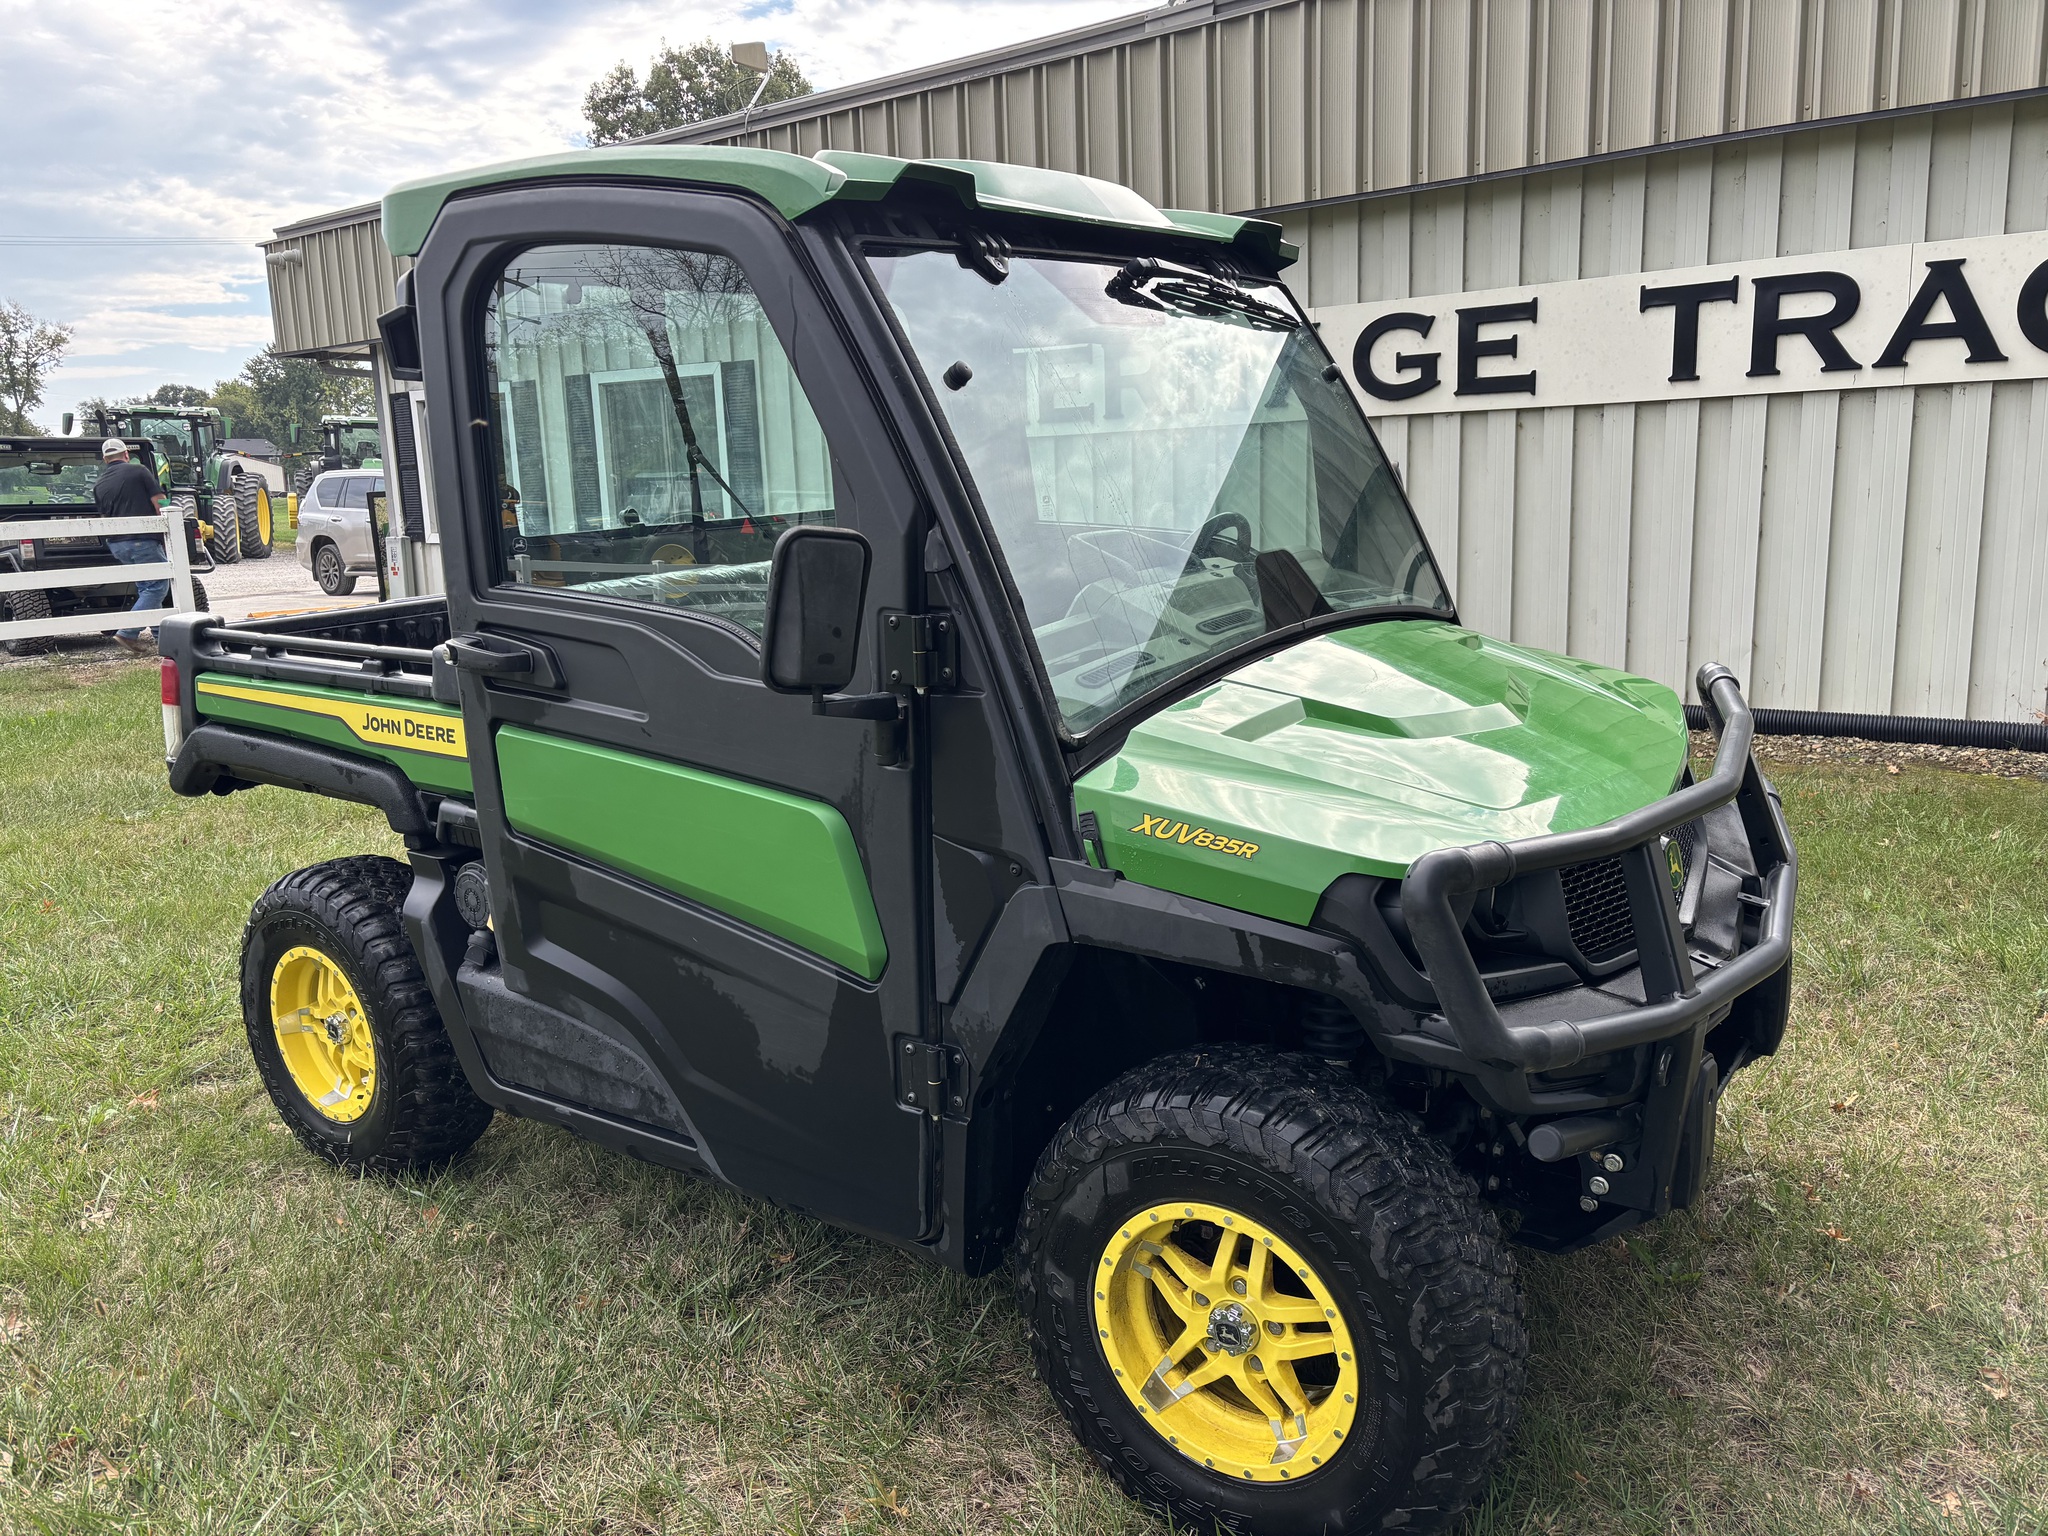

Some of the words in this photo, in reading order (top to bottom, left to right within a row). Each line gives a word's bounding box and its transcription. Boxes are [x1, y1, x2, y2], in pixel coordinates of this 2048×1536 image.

[1639, 257, 2048, 383] TRA
[362, 712, 402, 736] JOHN
[404, 718, 456, 744] DEERE
[1127, 813, 1260, 861] XUV835R
